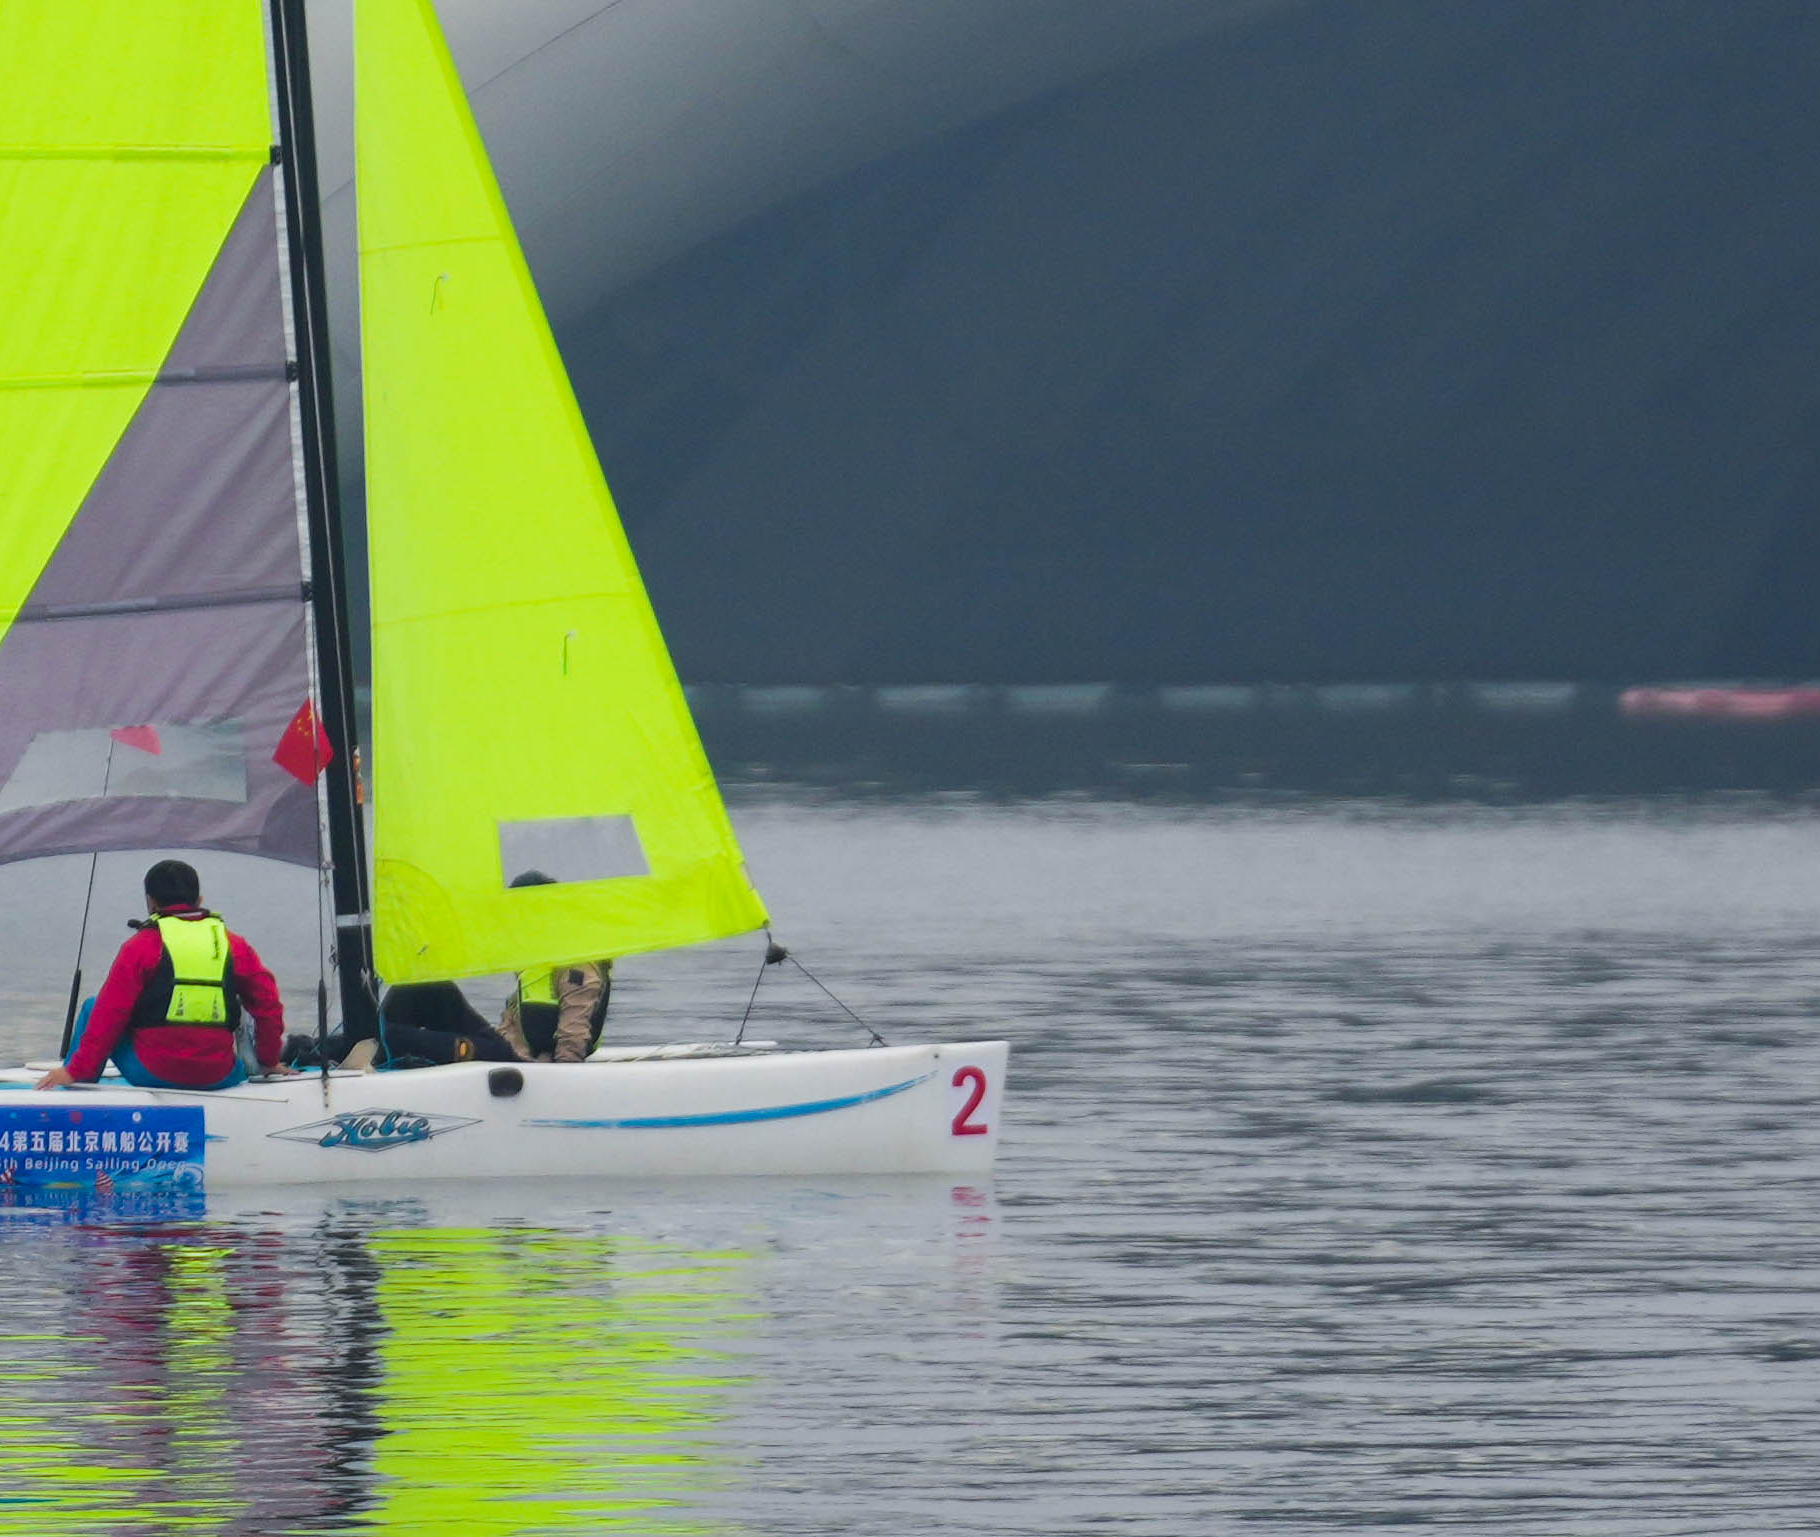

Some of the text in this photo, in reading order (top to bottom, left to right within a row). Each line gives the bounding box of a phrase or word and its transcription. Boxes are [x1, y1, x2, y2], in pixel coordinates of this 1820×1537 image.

[952, 1066, 988, 1136] 2
[25, 1156, 79, 1172] Beijing
[85, 1156, 140, 1173] Sailing
